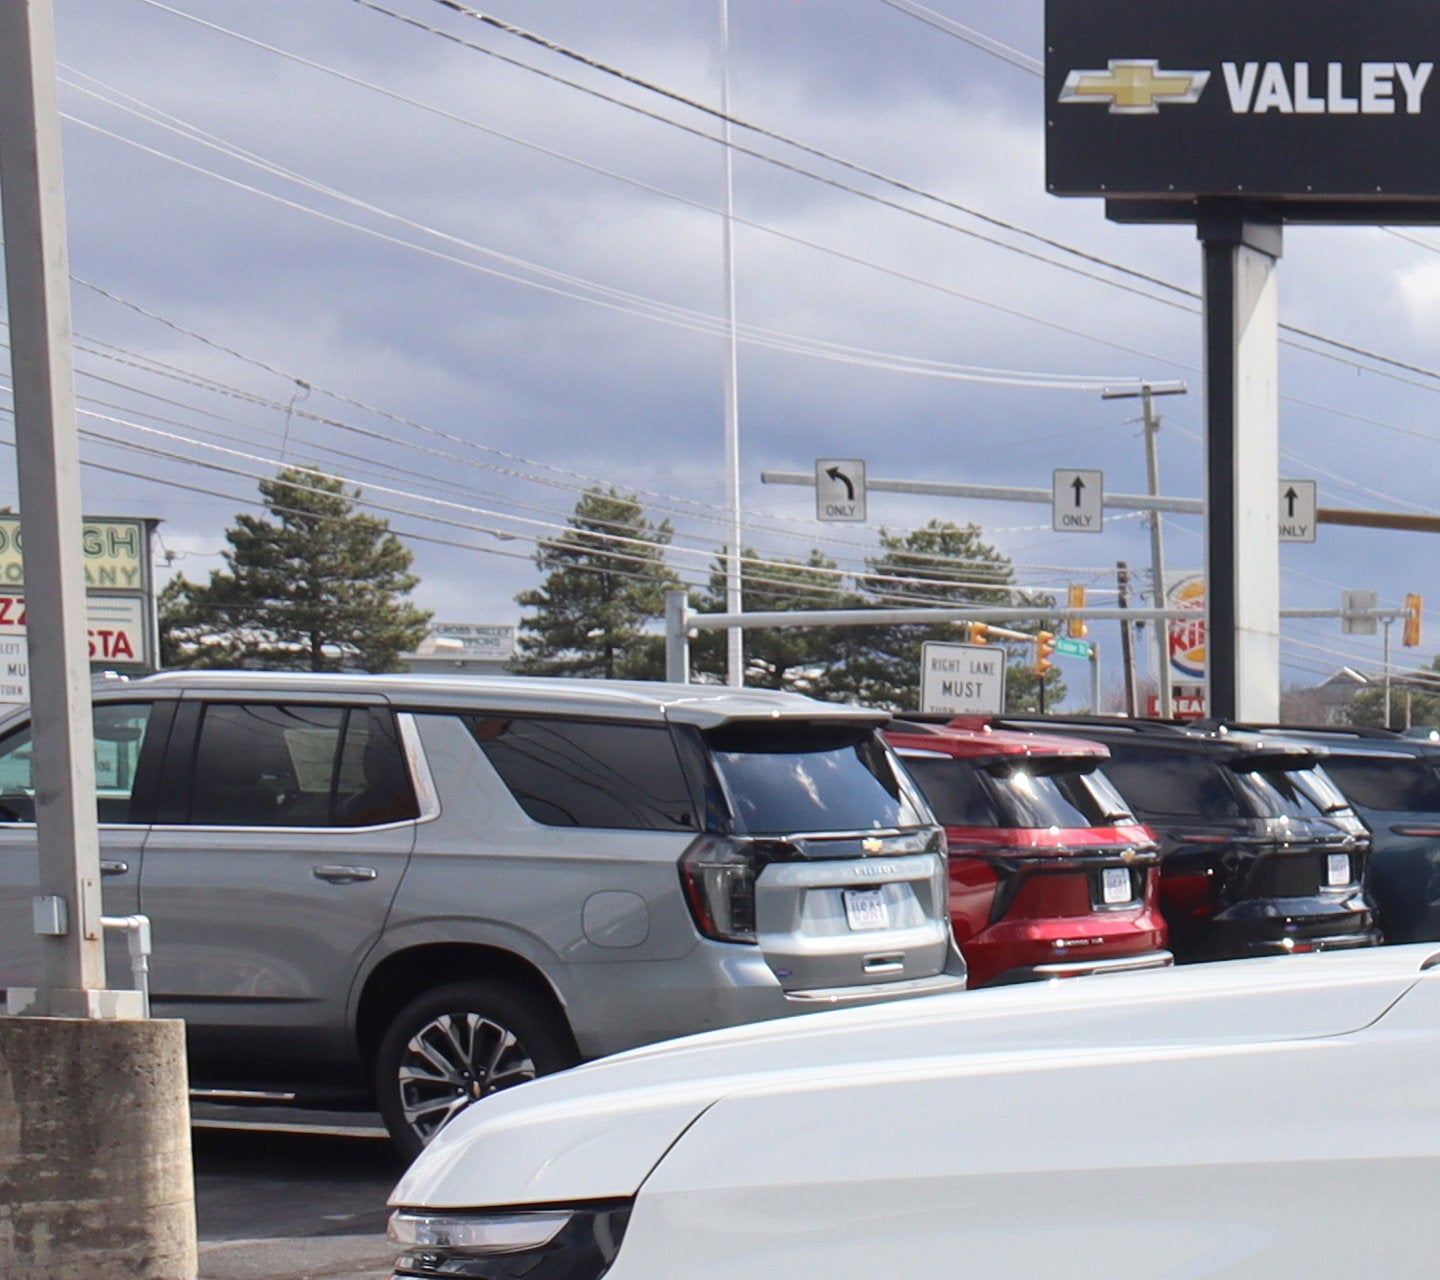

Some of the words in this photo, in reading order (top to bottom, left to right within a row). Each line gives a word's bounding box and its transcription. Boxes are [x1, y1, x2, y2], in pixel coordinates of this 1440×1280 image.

[1222, 62, 1432, 114] VALLEY
[826, 504, 855, 517] ONLY
[1062, 514, 1093, 527] ONLY
[1279, 525, 1308, 537] NLY
[87, 629, 134, 659] STA
[931, 657, 960, 673] RIGHT
[970, 660, 995, 676] LANE
[942, 680, 983, 698] MUST
